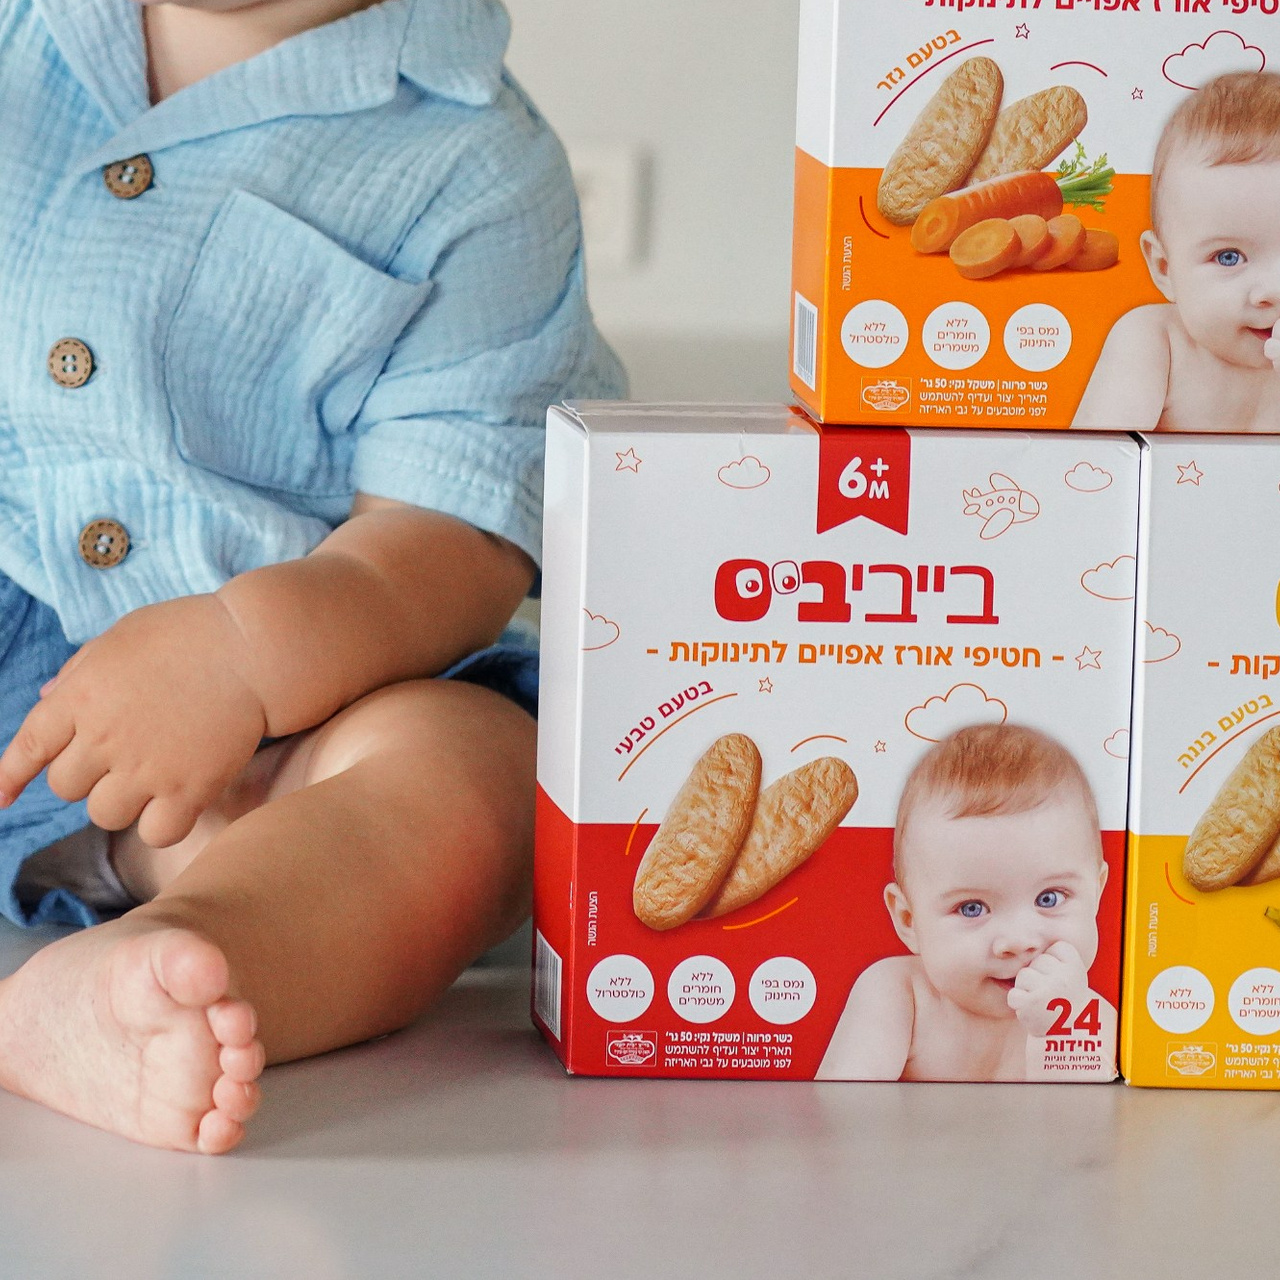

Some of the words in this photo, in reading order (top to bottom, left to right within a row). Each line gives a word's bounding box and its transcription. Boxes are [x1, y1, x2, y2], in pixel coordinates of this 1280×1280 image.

[907, 29, 962, 69] בטעם
[876, 67, 906, 94] גזר
[863, 321, 886, 332] ללא
[946, 318, 969, 328] ללא
[937, 331, 977, 340] חומרים
[1016, 326, 1035, 335] בפי
[1038, 327, 1060, 336] נמס
[849, 333, 900, 344] כולסטרול
[1019, 338, 1056, 349] התינוק
[933, 343, 980, 353] משמרים
[934, 377, 948, 389] 50
[966, 378, 996, 391] משקל
[1001, 380, 1027, 391] פרווה
[1028, 381, 1049, 391] כשר
[919, 391, 965, 402] להשתמש
[967, 392, 993, 404] ועדיף
[996, 393, 1015, 403] יצור
[1017, 393, 1047, 405] תאריך
[919, 404, 952, 414] האריזה
[954, 405, 968, 415] גבי
[970, 404, 984, 416] על
[986, 406, 1026, 416] מוטבעים
[1028, 406, 1047, 417] לפני
[669, 640, 788, 666] לתינוקות
[799, 644, 883, 664] אפויים
[895, 646, 953, 666] אורז
[965, 647, 1040, 667] חטיפי
[658, 680, 714, 720] בטעם
[1217, 694, 1273, 732] בטעם
[614, 715, 657, 758] טבעי
[1177, 730, 1217, 768] בננה
[609, 976, 632, 987] ללא
[691, 972, 714, 982] ללא
[682, 984, 722, 994] חומרים
[761, 979, 780, 989] בפי
[783, 980, 805, 989] נמס
[595, 988, 646, 999] כולסטרול
[764, 991, 801, 1002] התינוק
[678, 996, 725, 1006] משמרים
[1046, 998, 1101, 1036] 24
[680, 1031, 693, 1042] 50
[711, 1031, 741, 1044] משקל
[746, 1033, 772, 1043] פרווה
[772, 1033, 793, 1044] כשר
[664, 1044, 710, 1055] להשתמש
[712, 1045, 738, 1057] ועדיף
[741, 1045, 760, 1056] יצור
[1044, 1039, 1102, 1052] יחידות
[762, 1045, 792, 1058] תאריך
[664, 1057, 698, 1068] האריזה
[699, 1058, 714, 1068] גבי
[716, 1057, 729, 1069] על
[731, 1058, 771, 1069] מוטבעים
[773, 1057, 792, 1069] לפני
